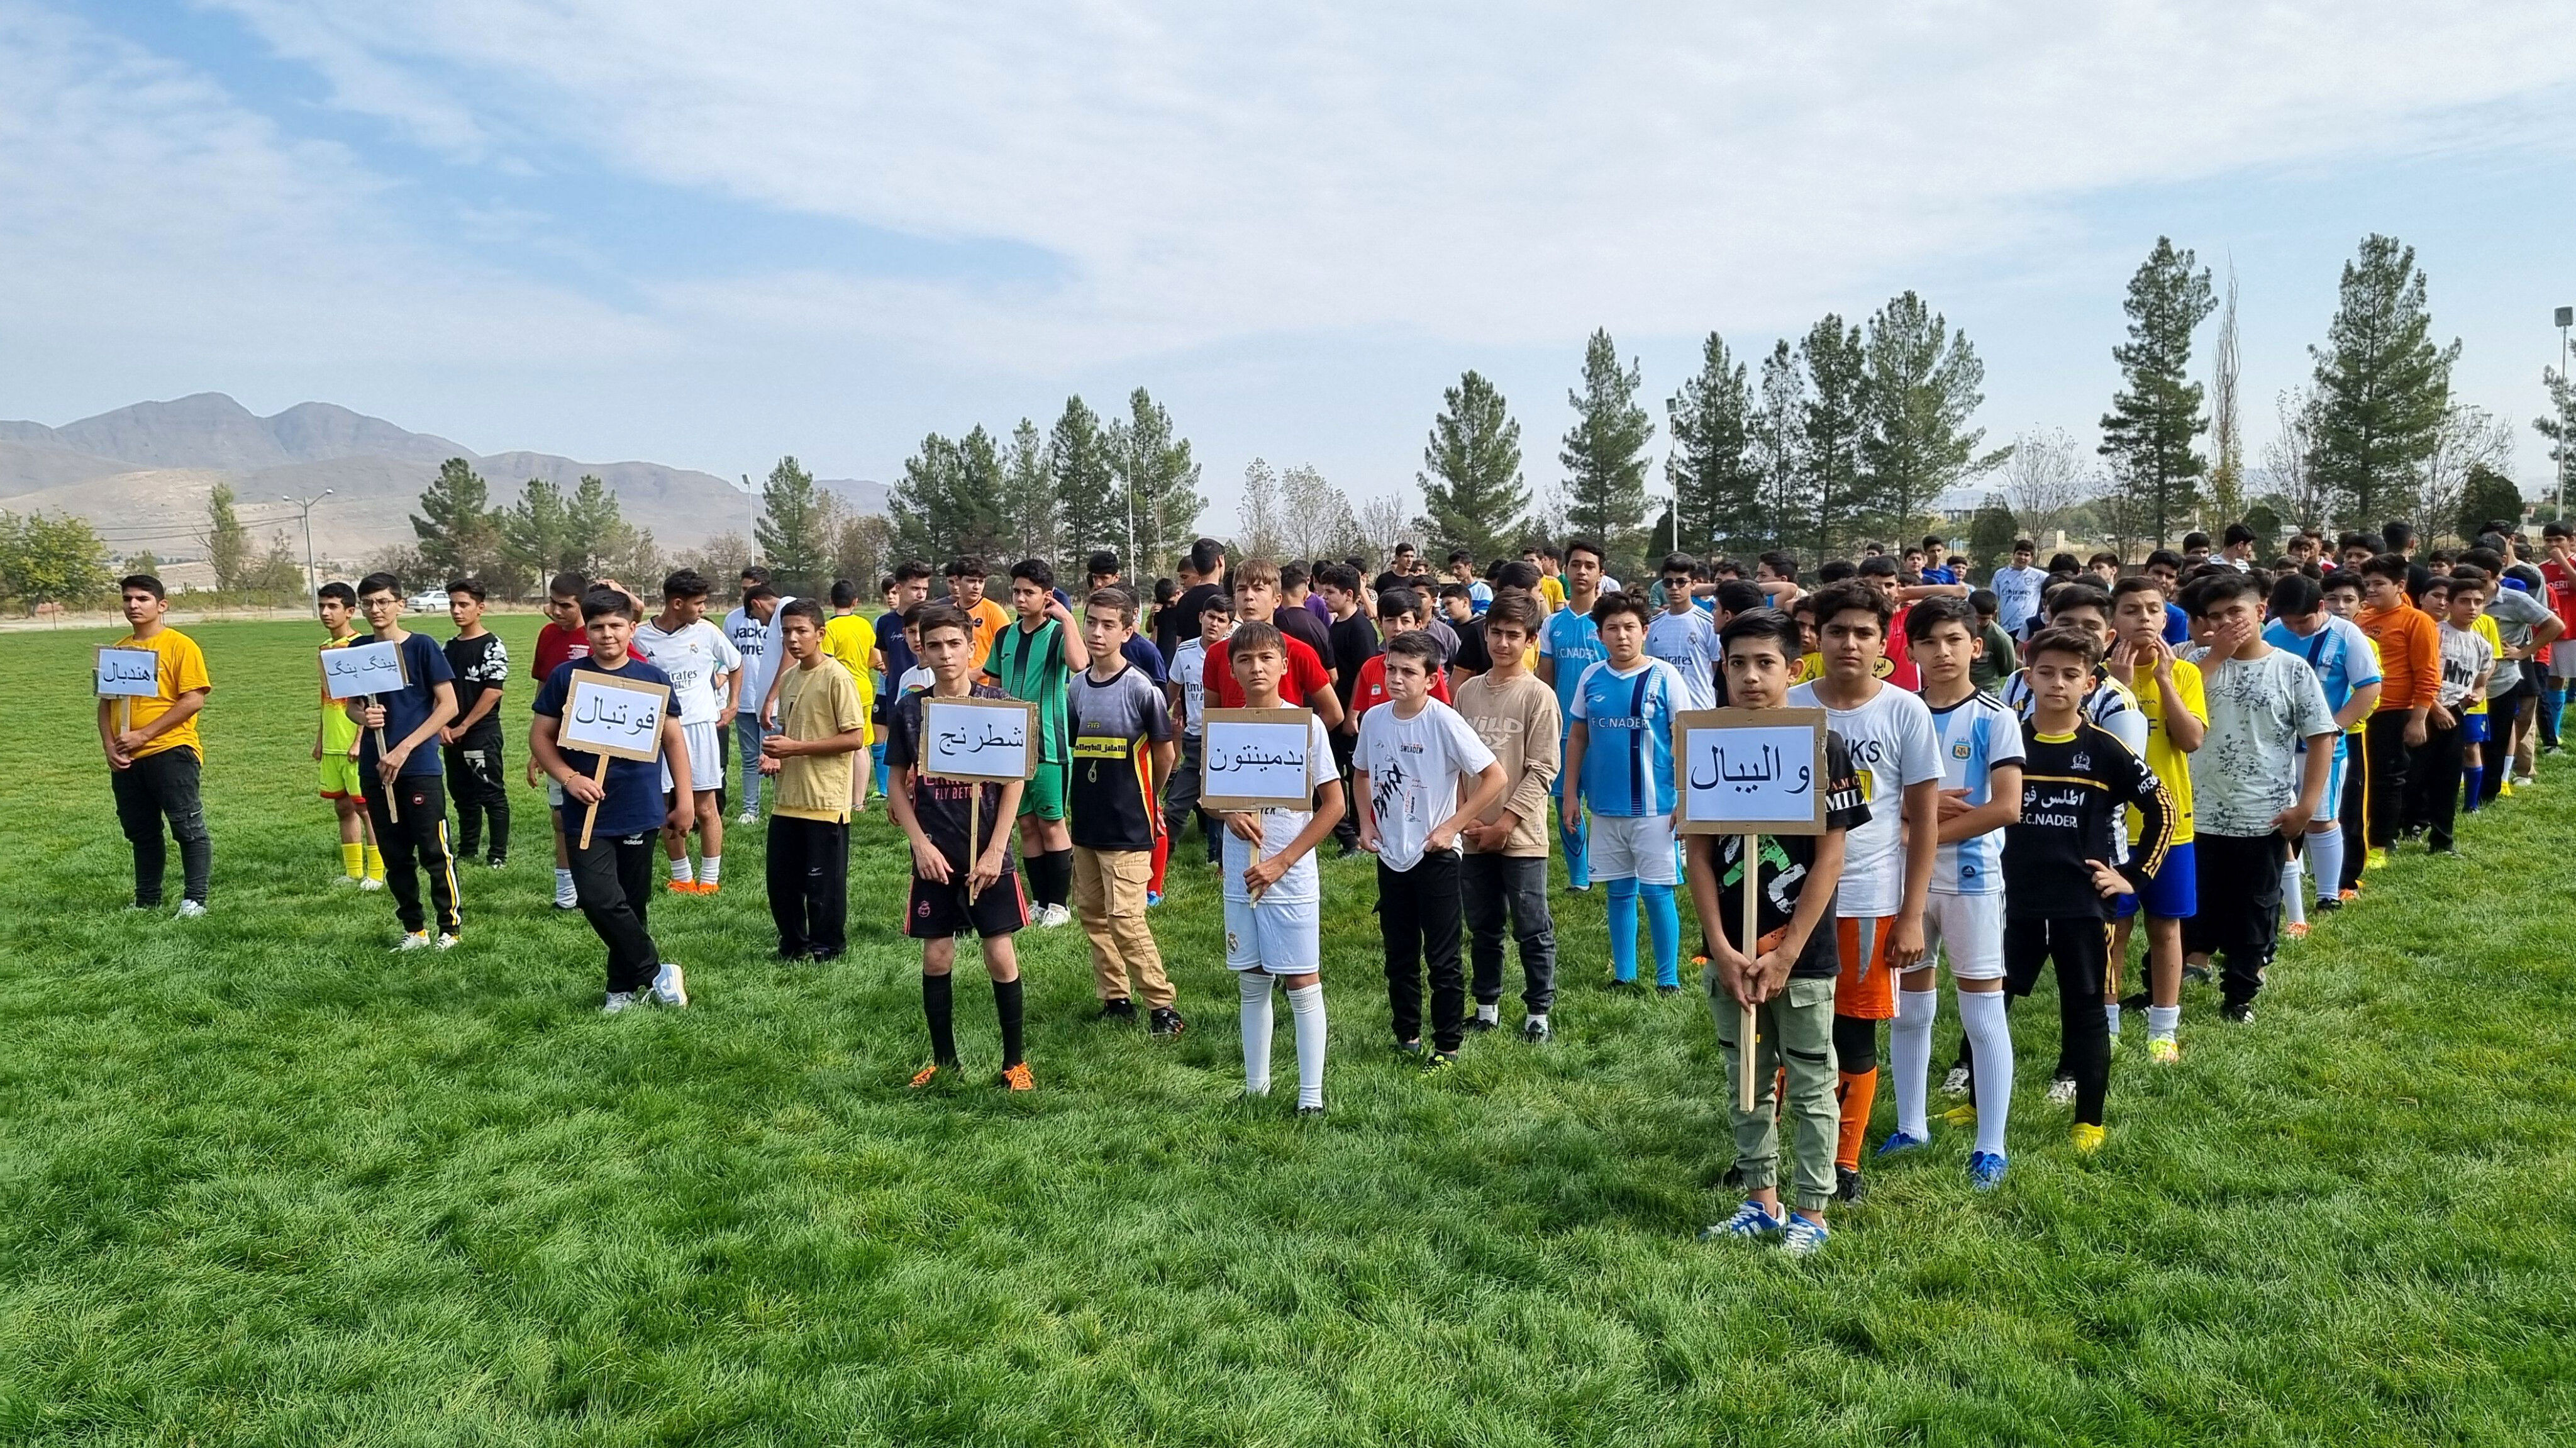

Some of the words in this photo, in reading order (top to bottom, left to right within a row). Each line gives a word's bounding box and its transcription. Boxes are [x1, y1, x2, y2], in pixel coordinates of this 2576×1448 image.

[103, 662, 150, 684] هندبال
[328, 660, 358, 679] پنگ
[362, 655, 397, 672] پینگ
[2443, 659, 2472, 687] NYC
[575, 695, 655, 735] فوتبال
[939, 723, 1023, 755] شطرنج
[1209, 745, 1304, 772] بدمینتون
[952, 786, 983, 799] BETTR
[2041, 789, 2086, 808] اطلس
